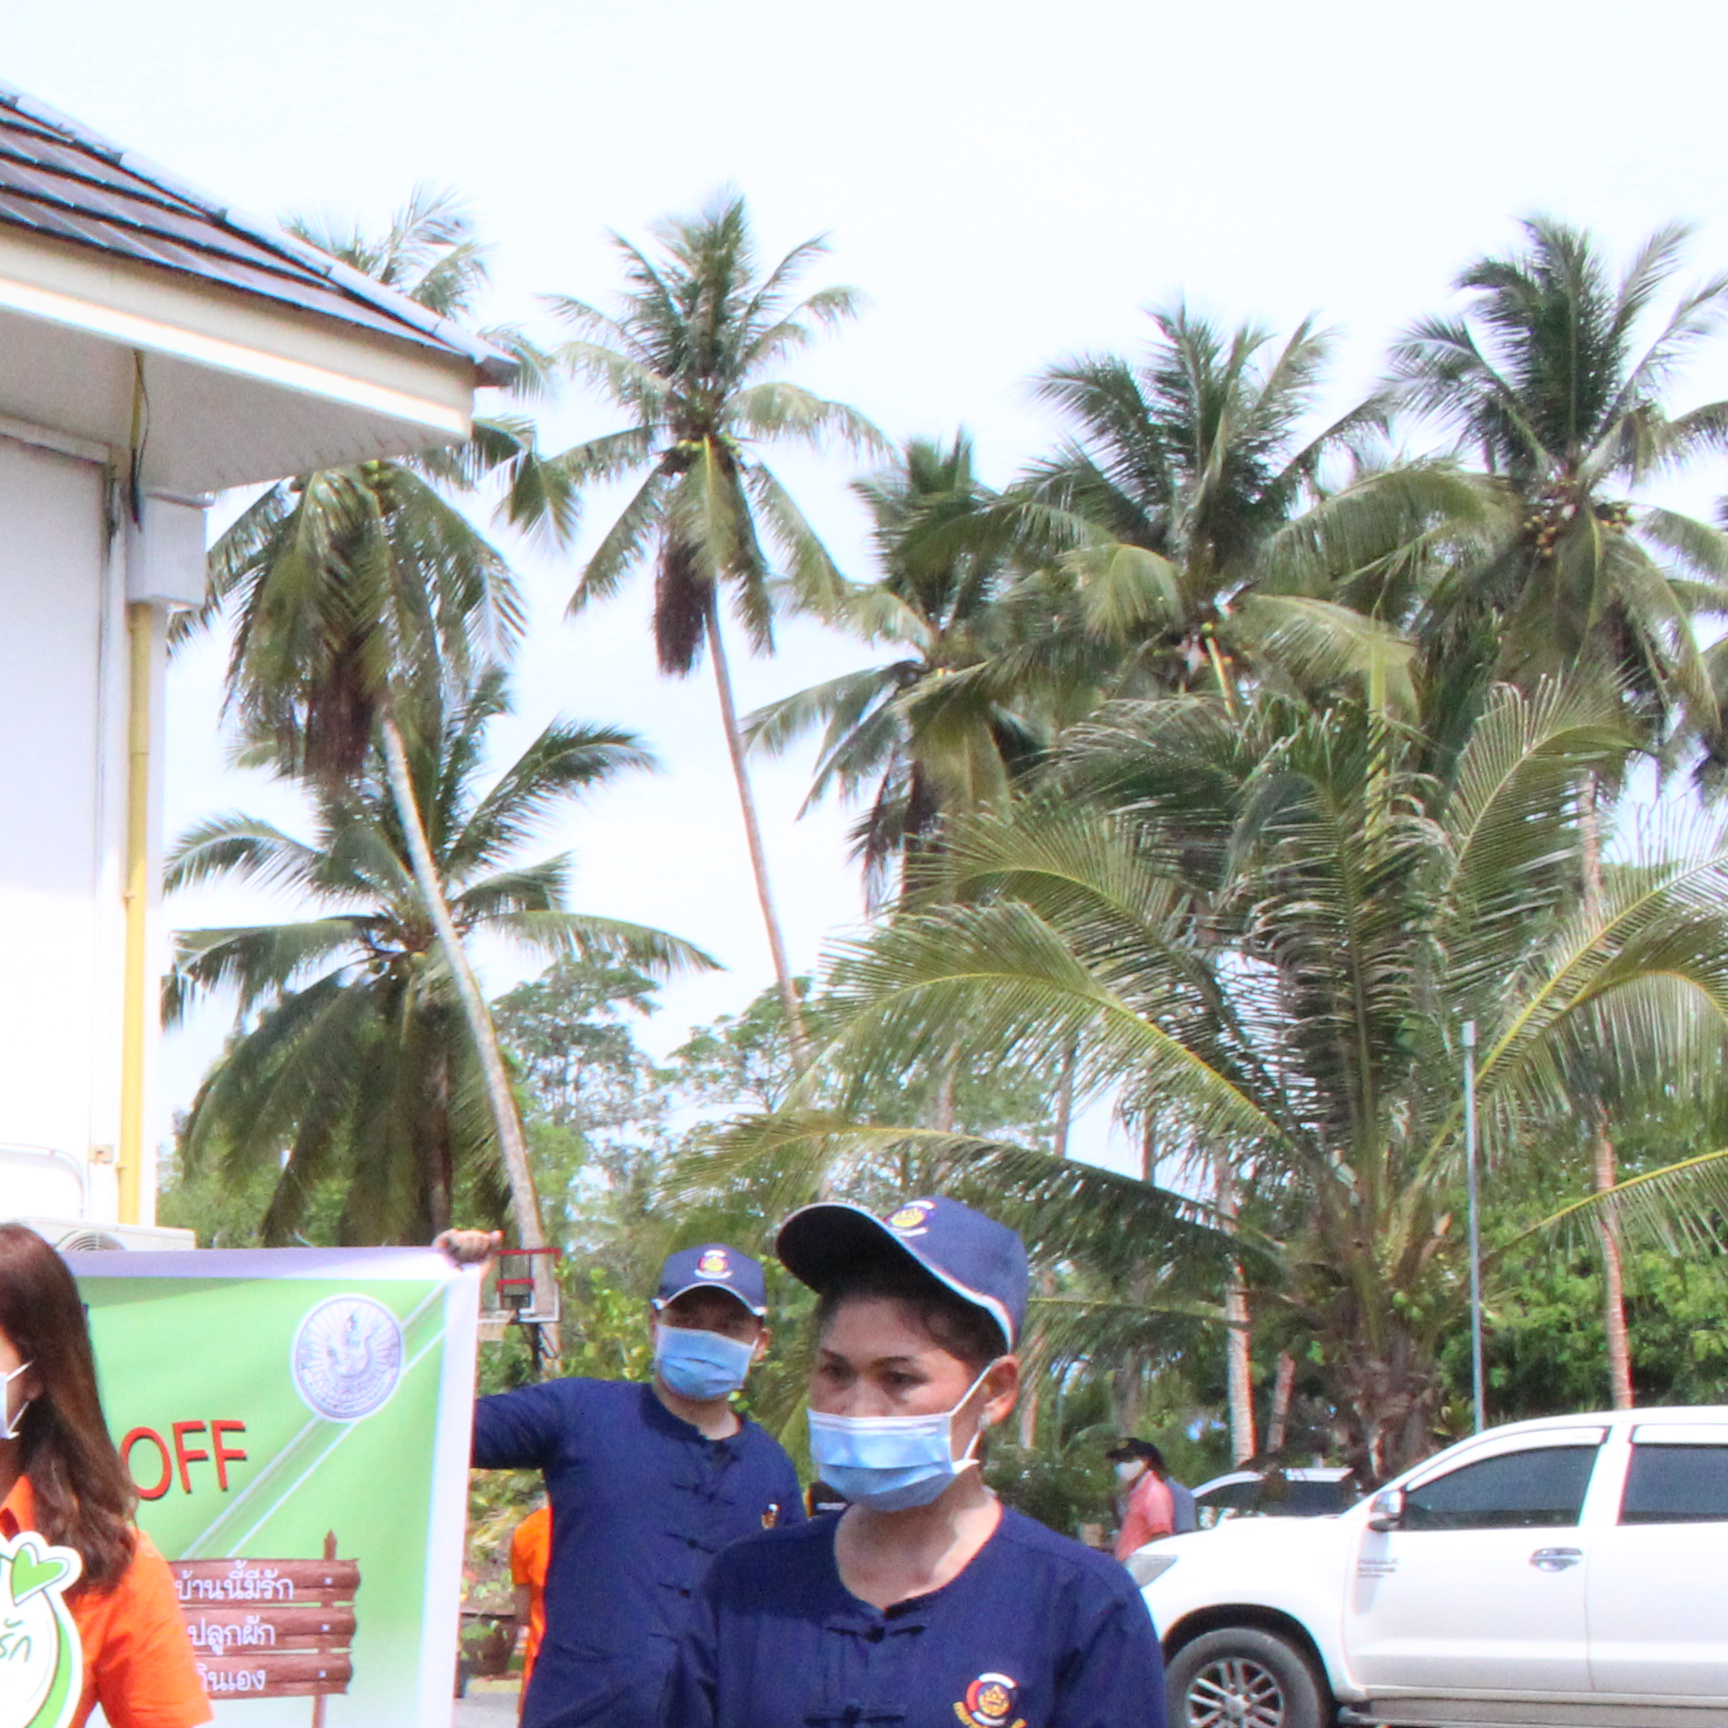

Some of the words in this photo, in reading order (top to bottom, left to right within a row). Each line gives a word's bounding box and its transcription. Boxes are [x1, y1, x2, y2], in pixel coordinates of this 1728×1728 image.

[119, 1419, 247, 1501] OFF
[187, 1614, 276, 1655] ปลูกผัก
